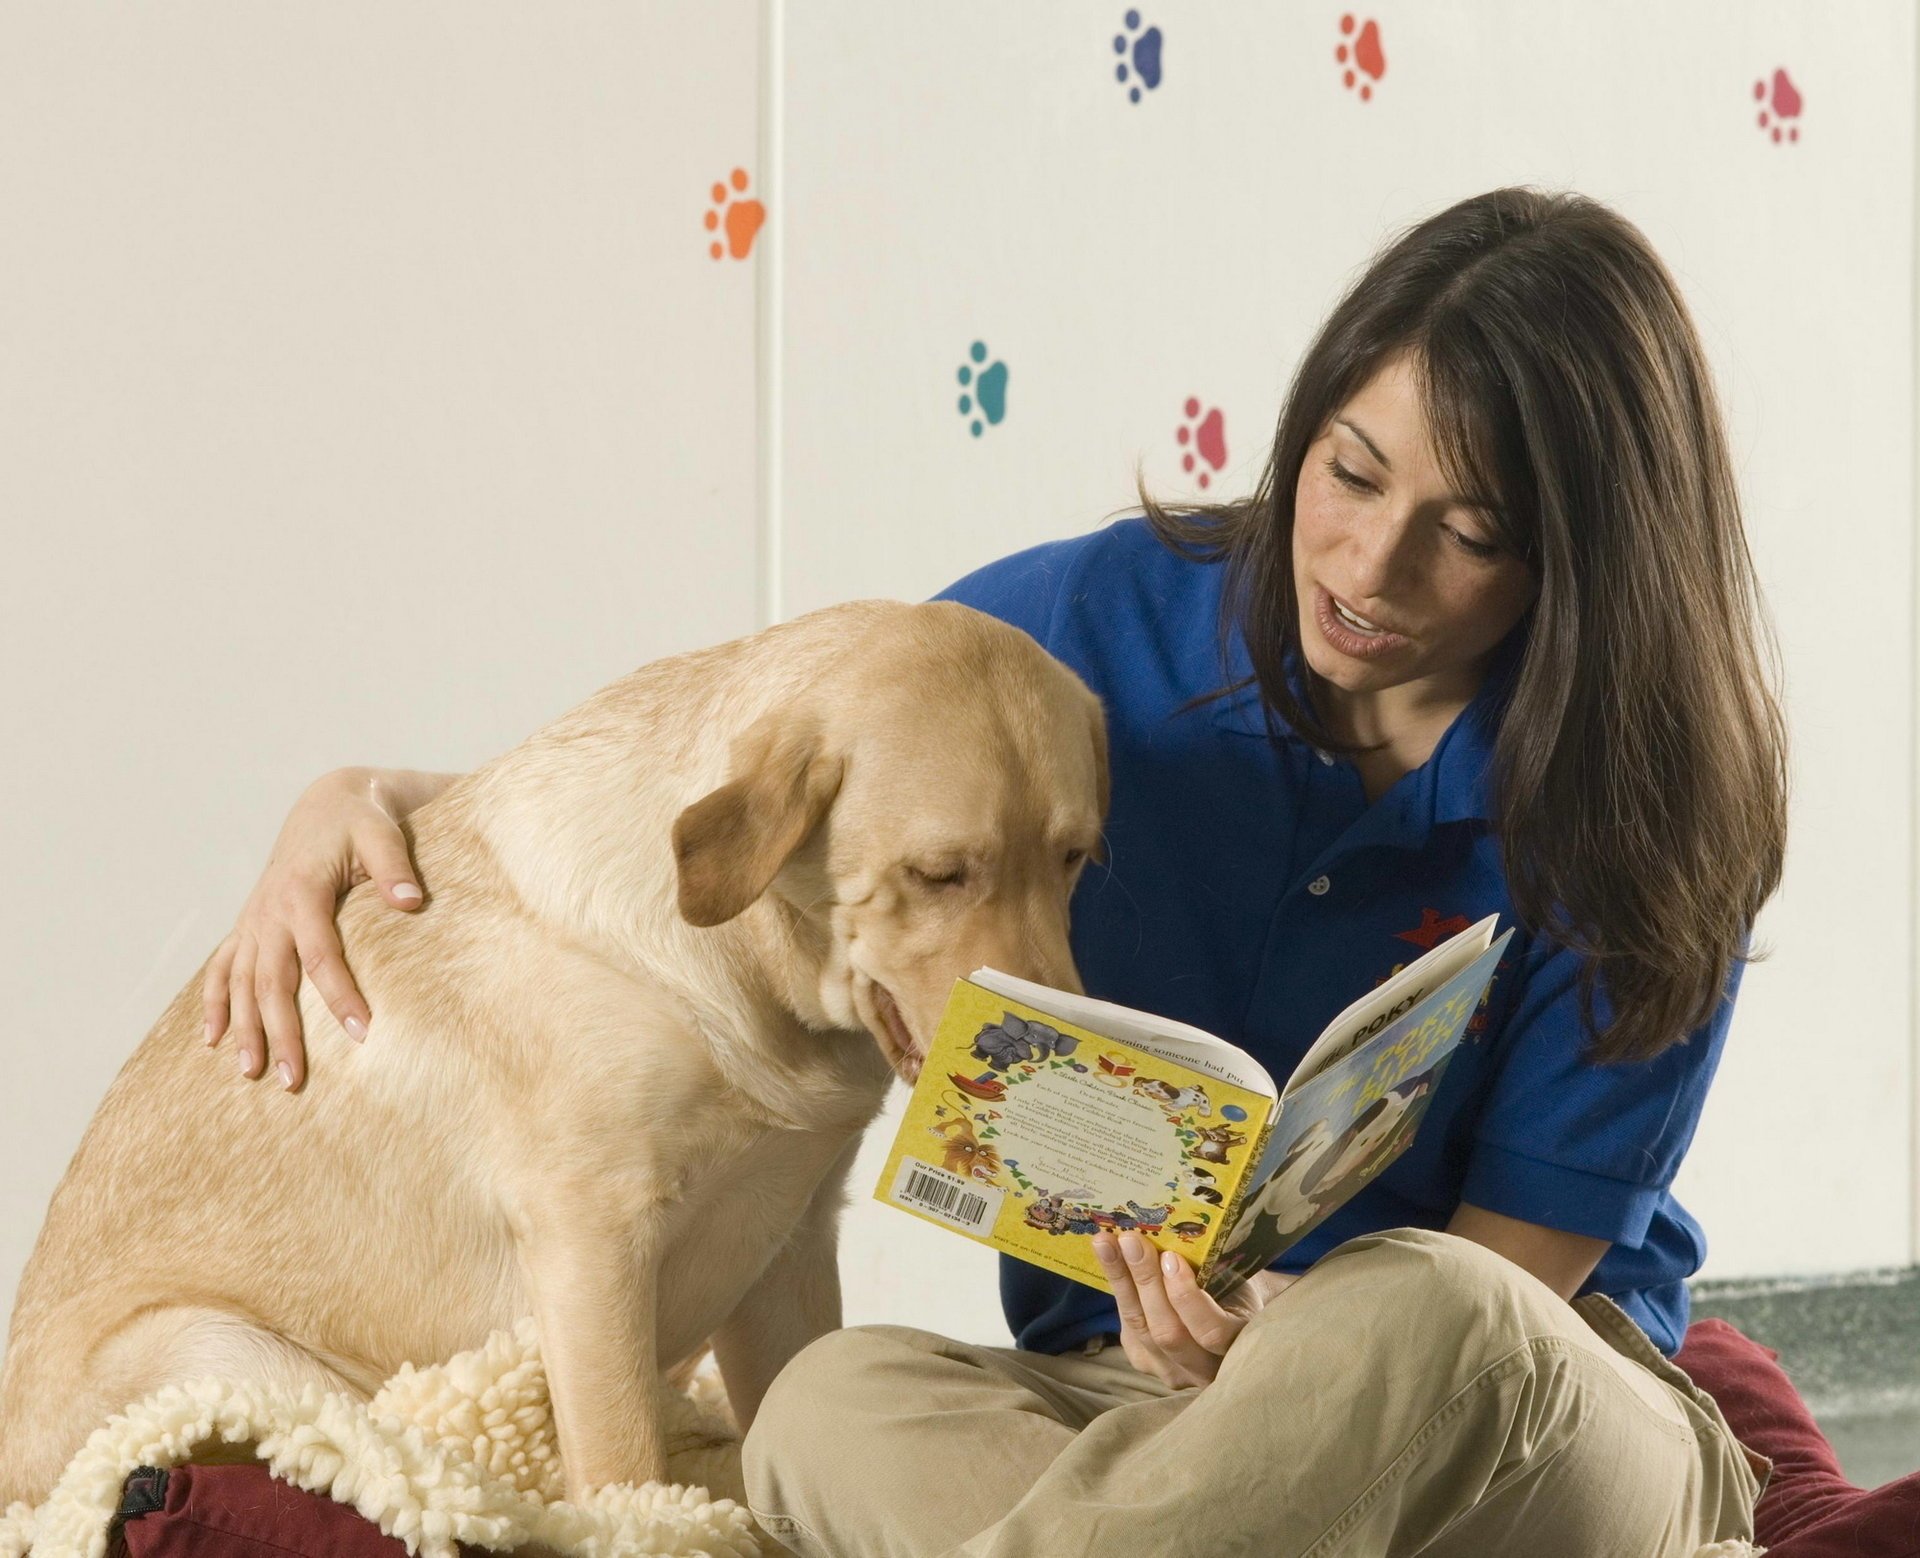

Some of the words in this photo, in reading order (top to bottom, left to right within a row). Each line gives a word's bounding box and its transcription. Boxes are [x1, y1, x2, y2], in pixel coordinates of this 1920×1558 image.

[1352, 988, 1425, 1046] POKY
[1153, 1047, 1201, 1065] someone
[1204, 1059, 1225, 1073] had
[1227, 1072, 1244, 1086] put
[914, 1161, 927, 1170] Our
[927, 1167, 945, 1177] Price
[898, 1194, 912, 1202] ISBN
